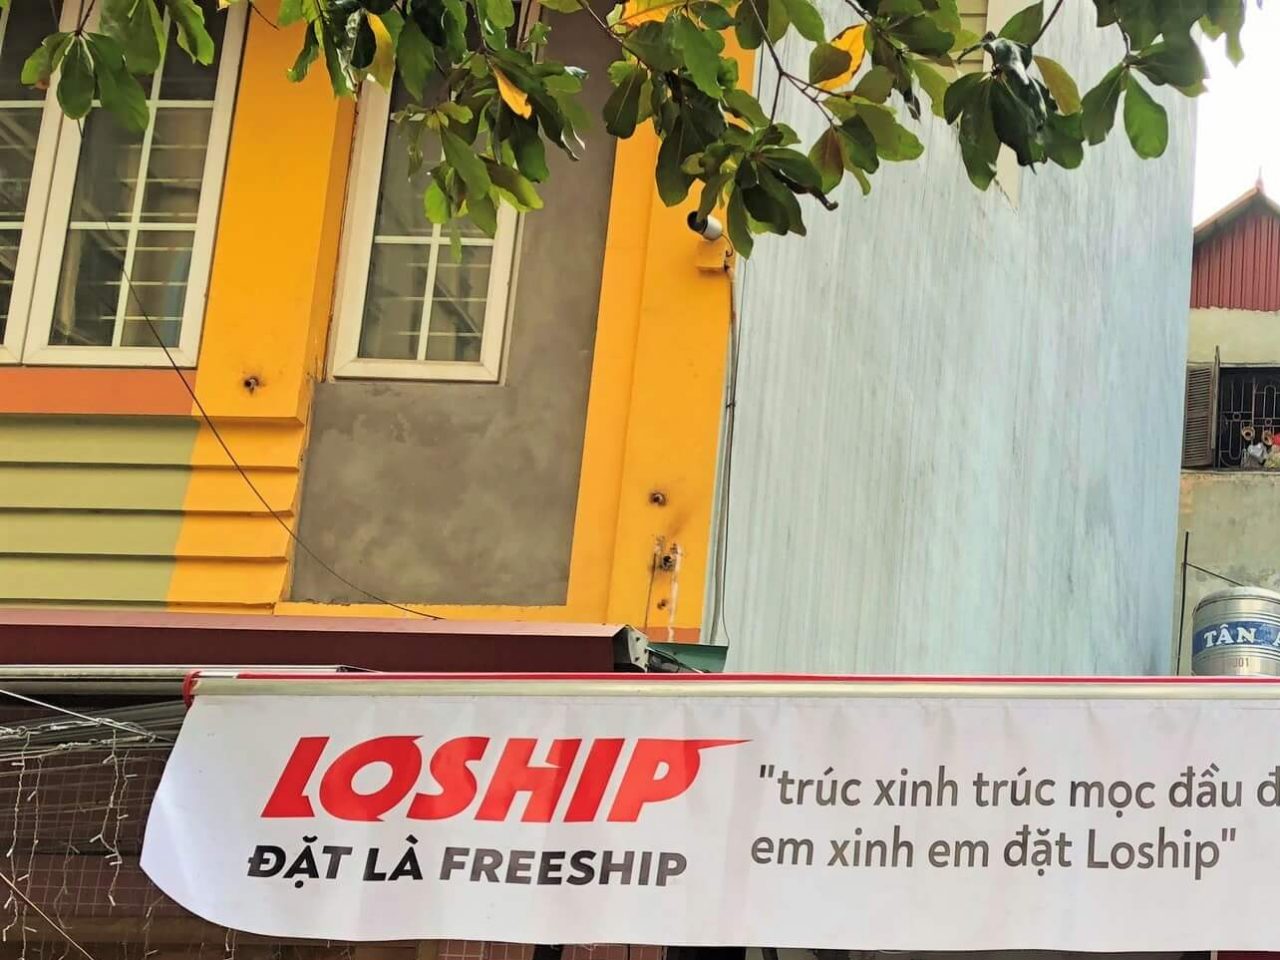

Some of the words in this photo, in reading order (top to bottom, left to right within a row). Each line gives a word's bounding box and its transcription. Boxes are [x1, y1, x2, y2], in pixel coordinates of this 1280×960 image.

[1203, 624, 1257, 648] TÂN
[260, 735, 752, 823] LOSHIP
[759, 763, 861, 808] "trúc
[873, 765, 958, 809] xinh
[972, 764, 1056, 809] trúc
[1069, 776, 1157, 819] mọc
[1168, 760, 1243, 811] đầu
[247, 834, 354, 889] ĐẶT
[363, 834, 424, 882] LÀ
[438, 846, 689, 888] FREESHIP
[750, 834, 815, 867] em
[826, 825, 914, 868] xinh
[927, 834, 990, 869] em
[1002, 824, 1073, 877] đặt
[1087, 826, 1237, 881] Loship"
